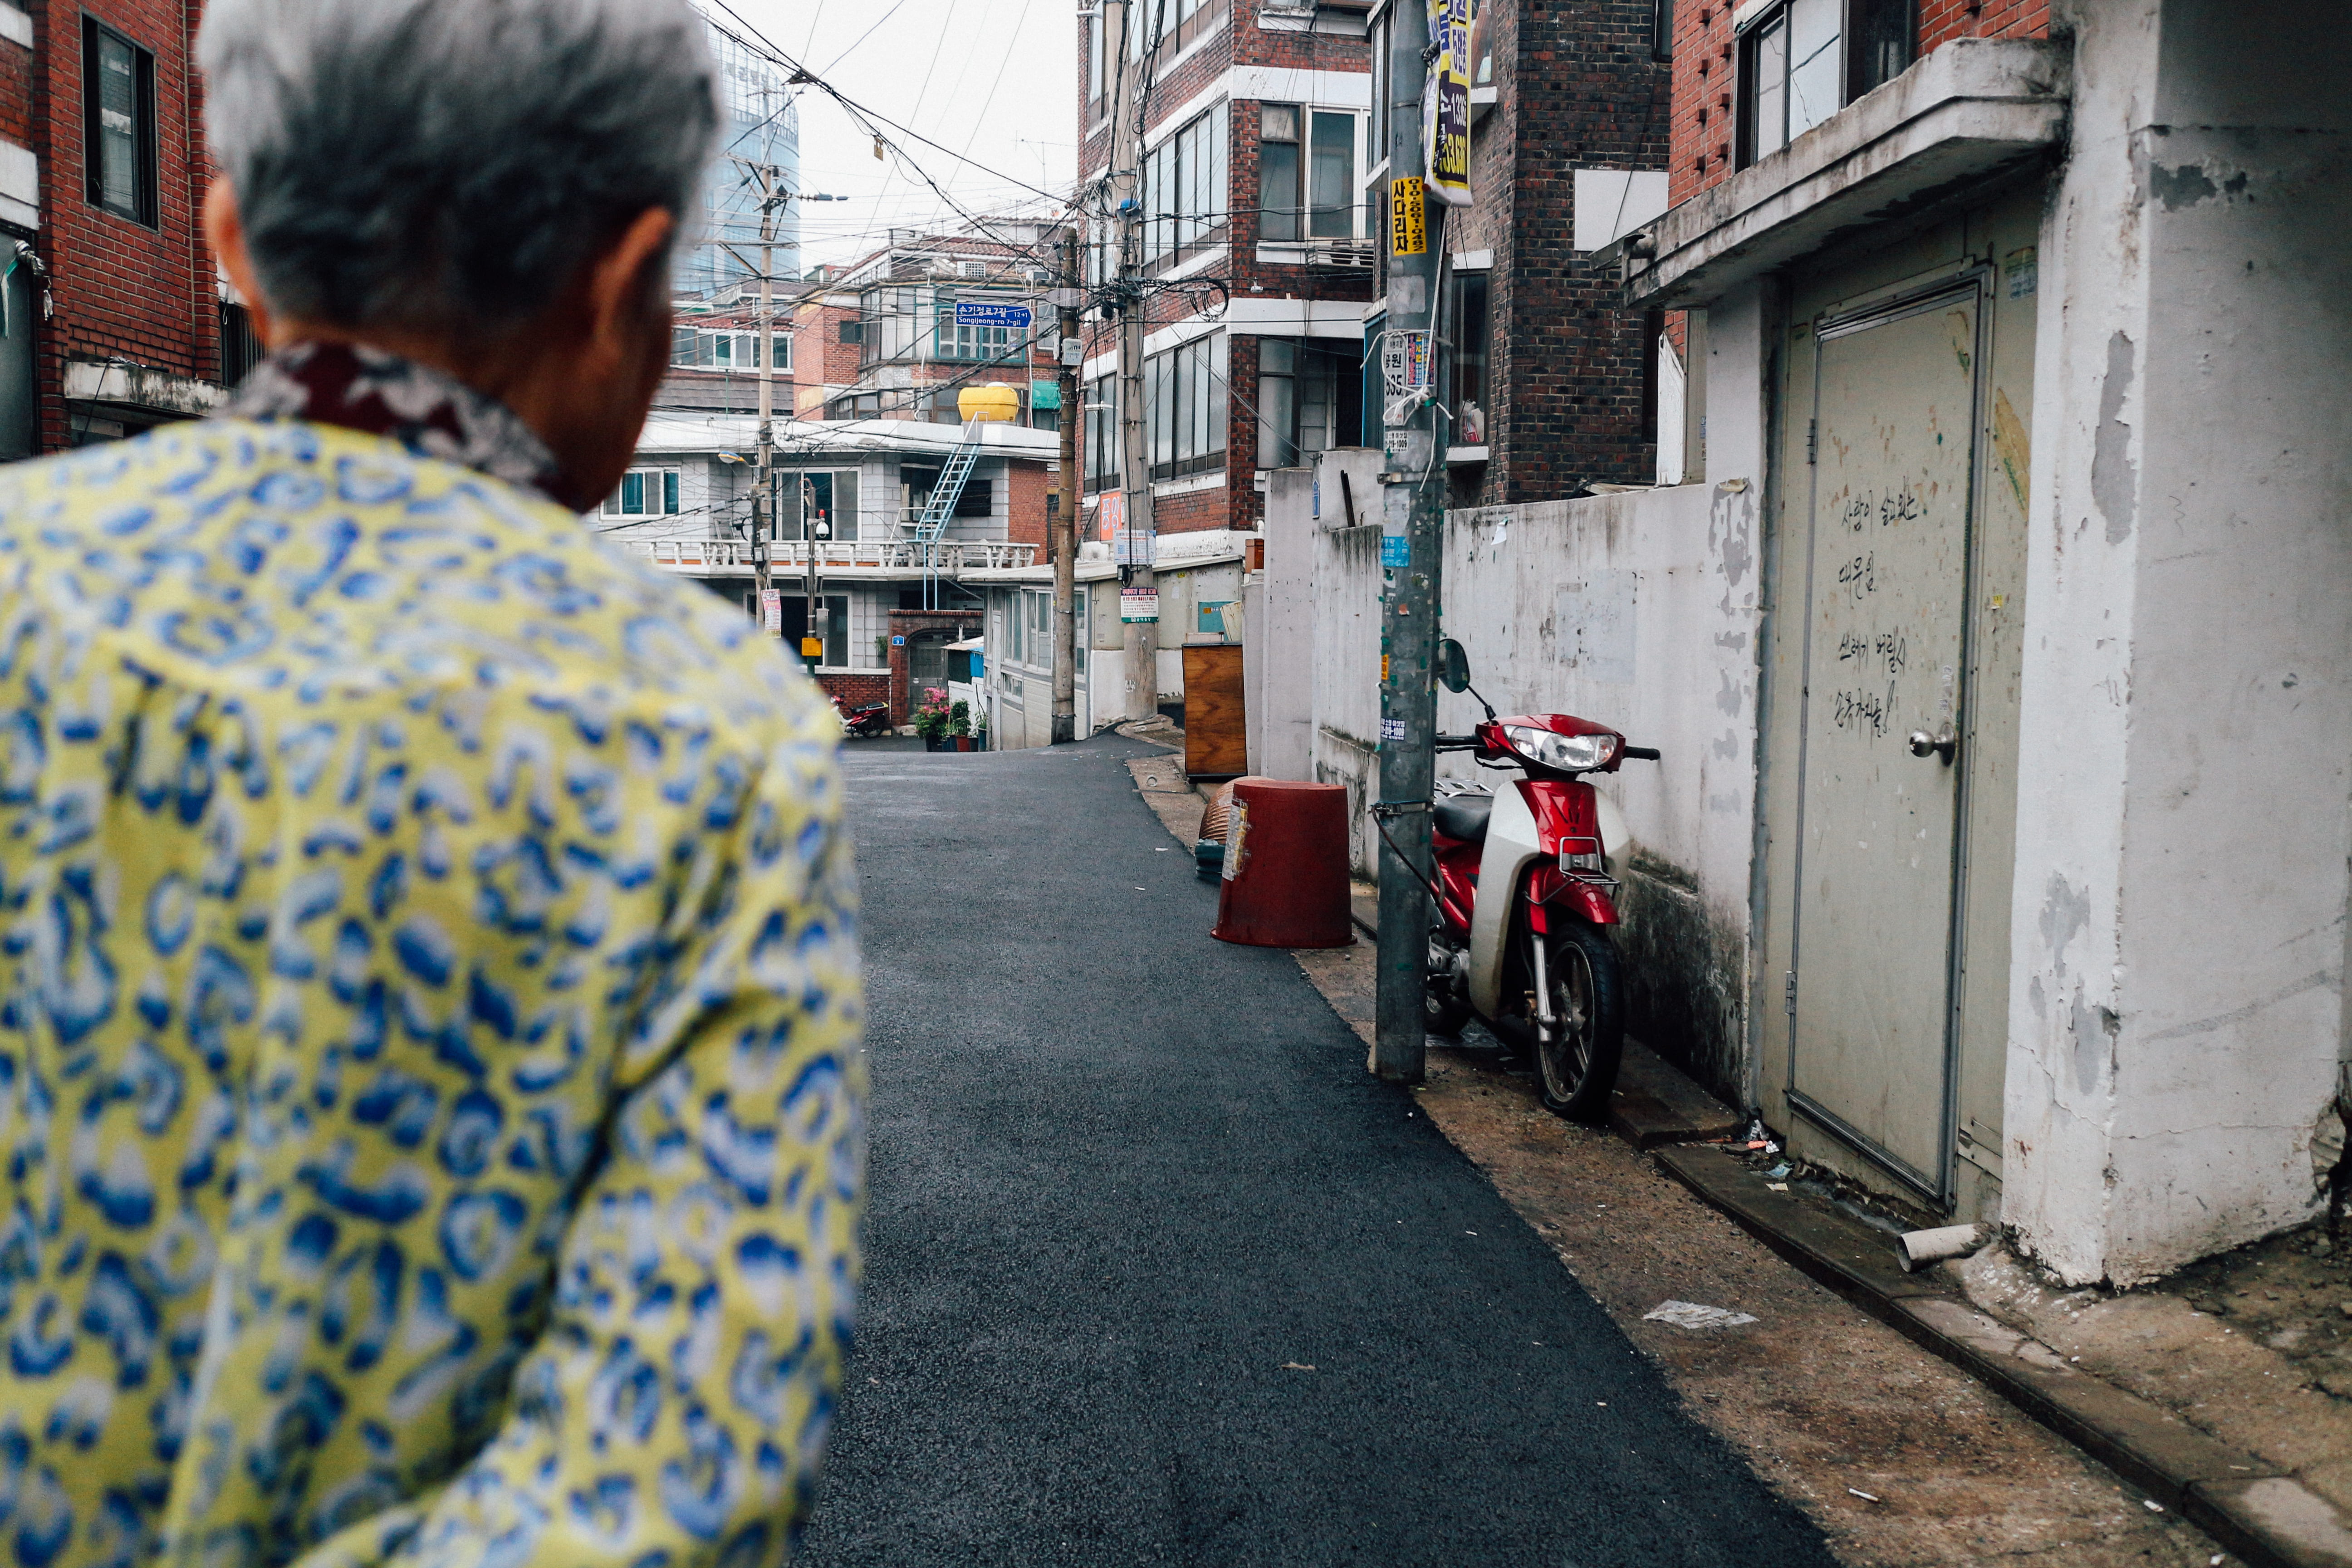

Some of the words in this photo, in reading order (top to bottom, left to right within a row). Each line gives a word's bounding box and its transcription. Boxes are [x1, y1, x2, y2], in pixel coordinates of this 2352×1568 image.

[1394, 181, 1408, 252] 사다리차
[958, 305, 1007, 318] 손기정로7길
[958, 316, 1005, 325] Songijeong-ro
